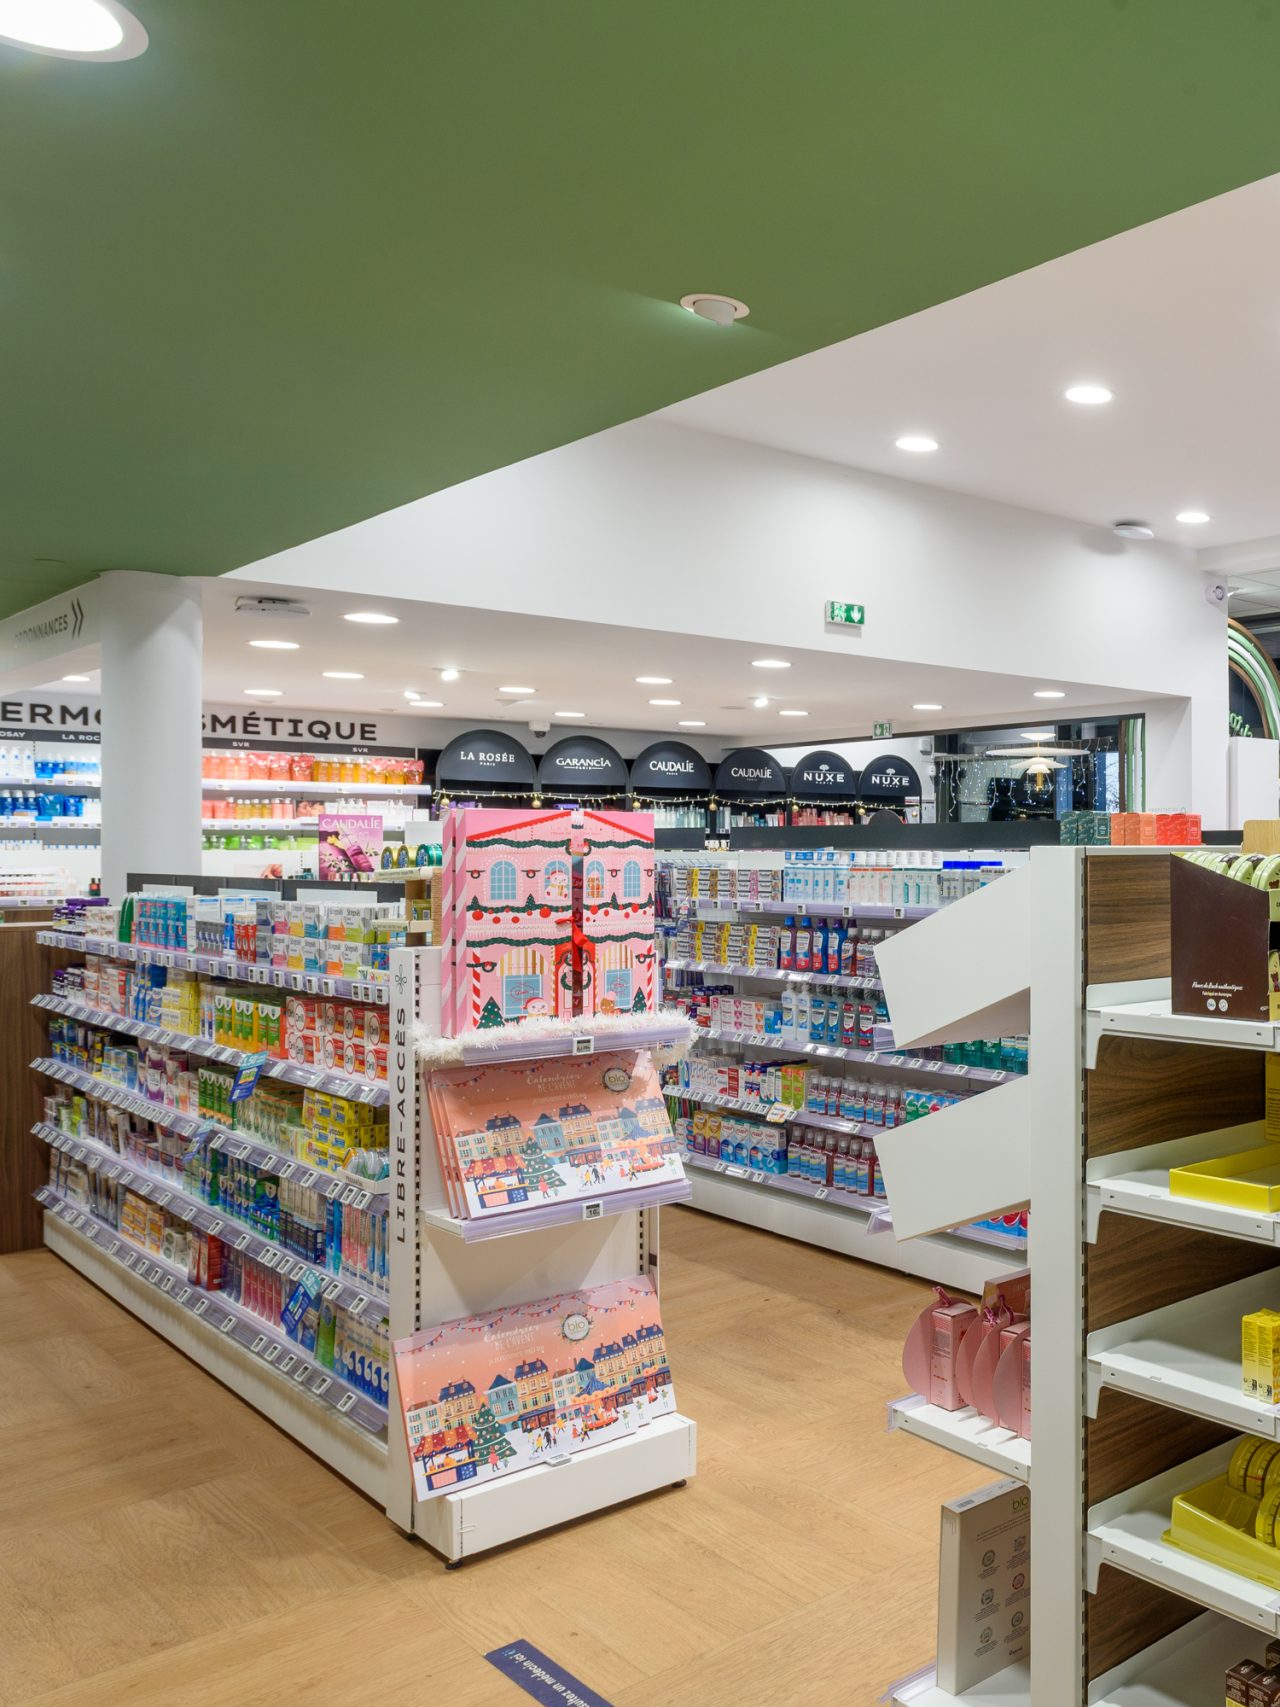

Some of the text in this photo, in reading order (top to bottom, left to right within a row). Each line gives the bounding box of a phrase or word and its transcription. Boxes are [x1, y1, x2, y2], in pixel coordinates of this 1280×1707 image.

[15, 613, 68, 641] DONNANCES
[460, 751, 515, 763] LA ROSÉE
[803, 772, 845, 783] NUXE
[871, 776, 910, 786] NUXE
[395, 1008, 405, 1243] LIBRE-ACCÈS
[509, 1652, 524, 1664] ici
[522, 1660, 556, 1685] médecin
[552, 1682, 566, 1693] un
